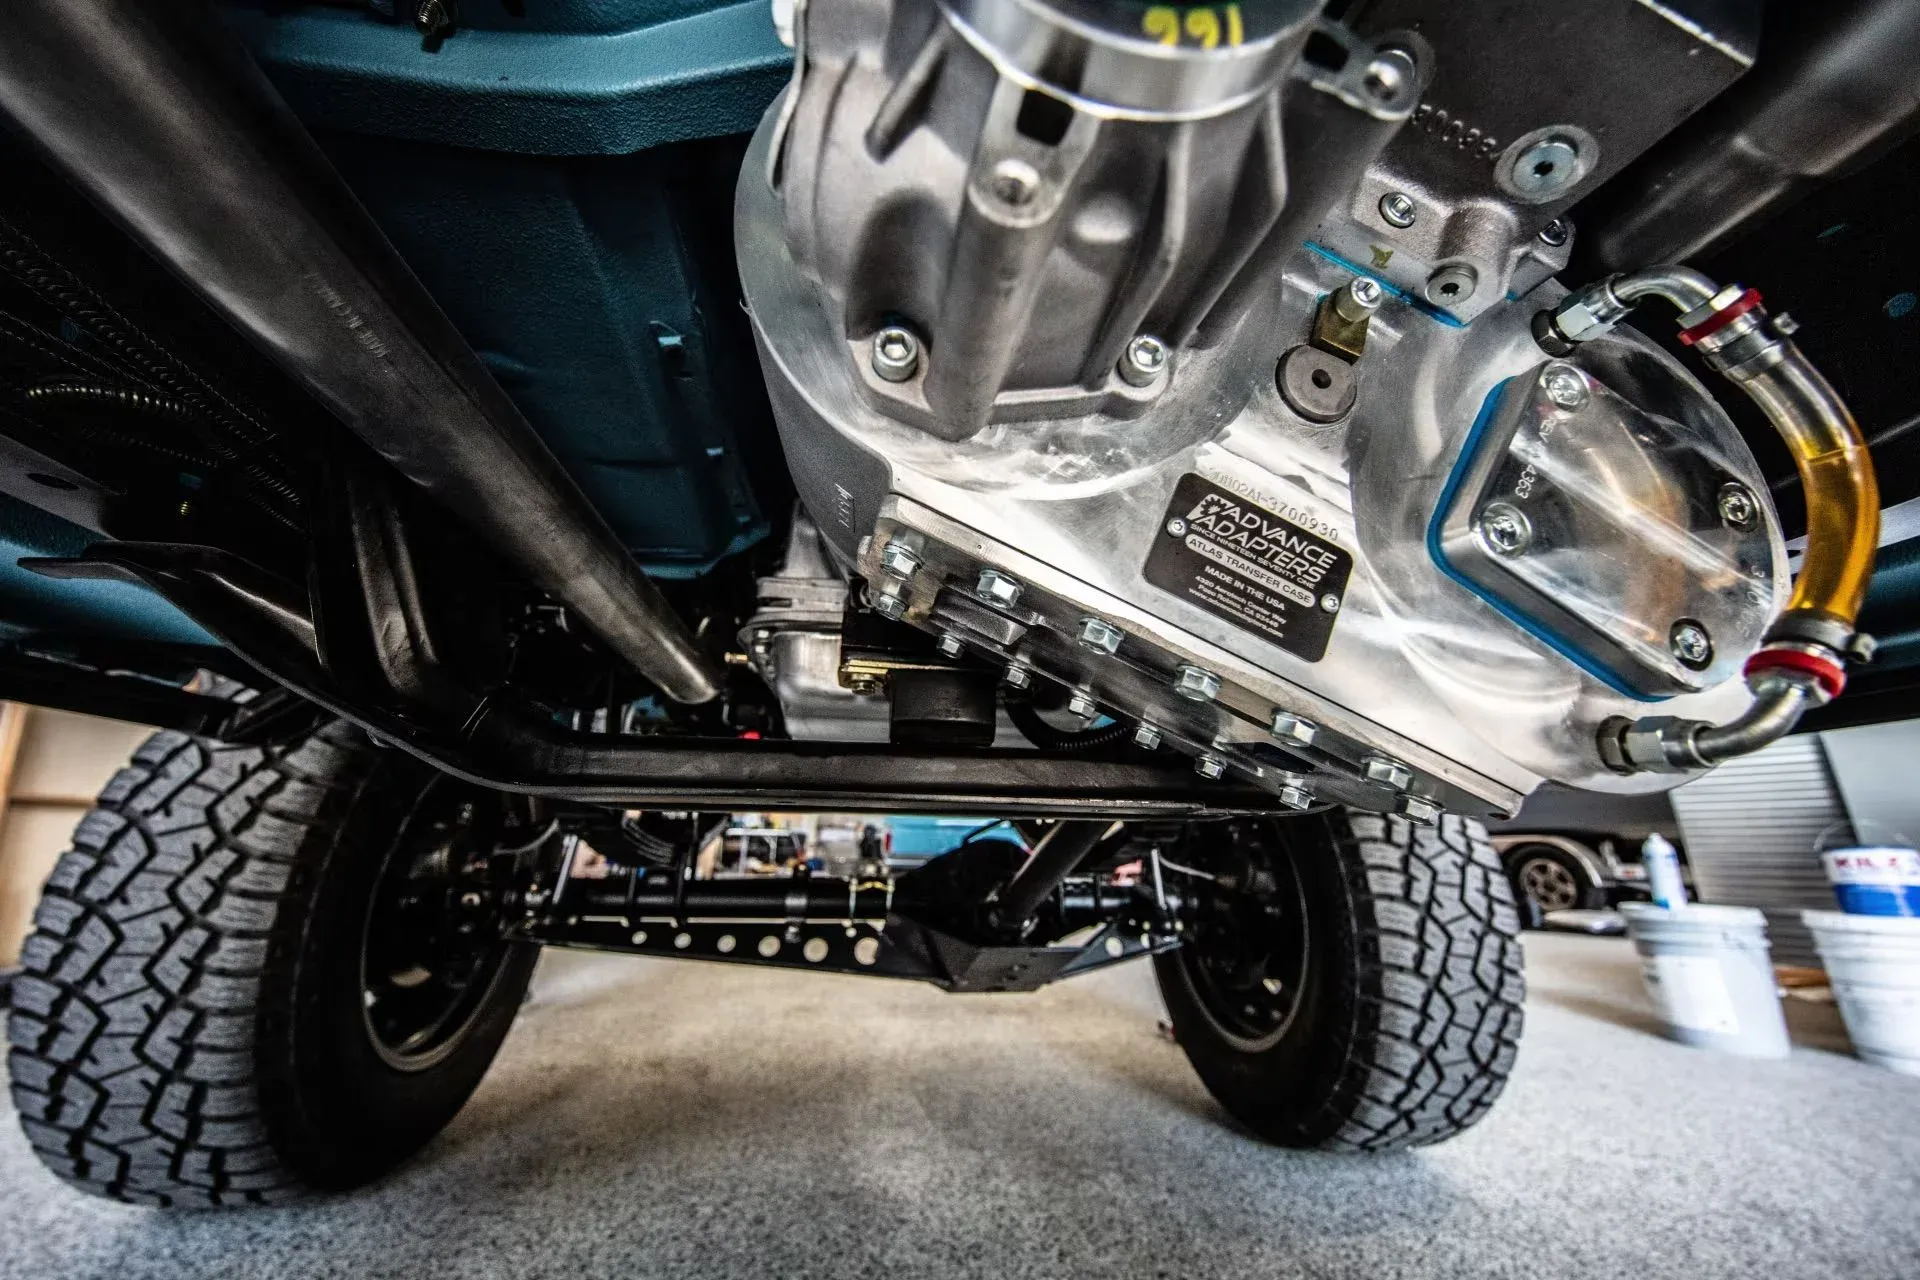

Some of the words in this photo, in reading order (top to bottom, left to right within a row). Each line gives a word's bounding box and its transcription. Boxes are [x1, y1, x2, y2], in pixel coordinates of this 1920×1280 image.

[1190, 523, 1215, 539] SINCE
[1216, 536, 1256, 559] NINETEEN
[1256, 556, 1296, 578] SEVENTY
[1296, 577, 1314, 589] ONE
[1196, 514, 1326, 584] ADAPTERS
[1220, 505, 1337, 569] ADVANCE
[1189, 538, 1223, 559] ATLAS
[1226, 555, 1280, 588] TRANSFER
[1282, 584, 1311, 603] CASE
[1204, 565, 1233, 583] MADE
[1233, 579, 1244, 589] IN
[1246, 585, 1264, 600] THE
[1265, 595, 1284, 610] USA
[1243, 607, 1254, 615] CA
[1271, 613, 1286, 624] Way
